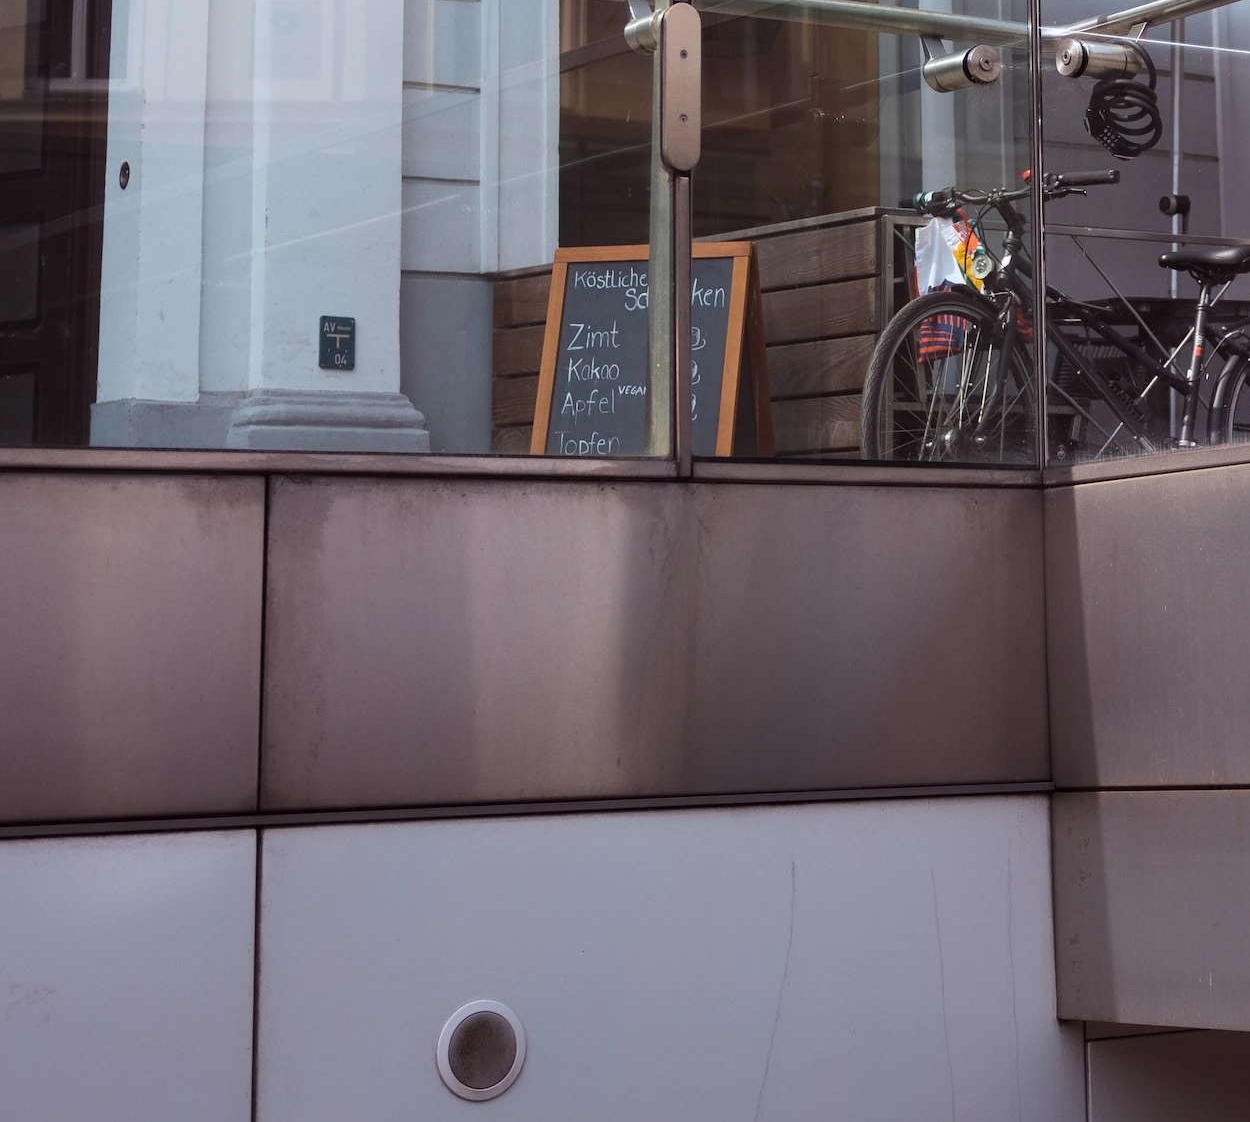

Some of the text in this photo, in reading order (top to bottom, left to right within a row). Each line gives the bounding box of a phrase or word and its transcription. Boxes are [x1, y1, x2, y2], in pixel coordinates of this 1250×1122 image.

[574, 267, 649, 289] Köstliche
[567, 321, 620, 351] Zimt
[567, 358, 620, 382] Kakao
[560, 389, 616, 425] Apfel
[554, 431, 620, 456] Topfen
